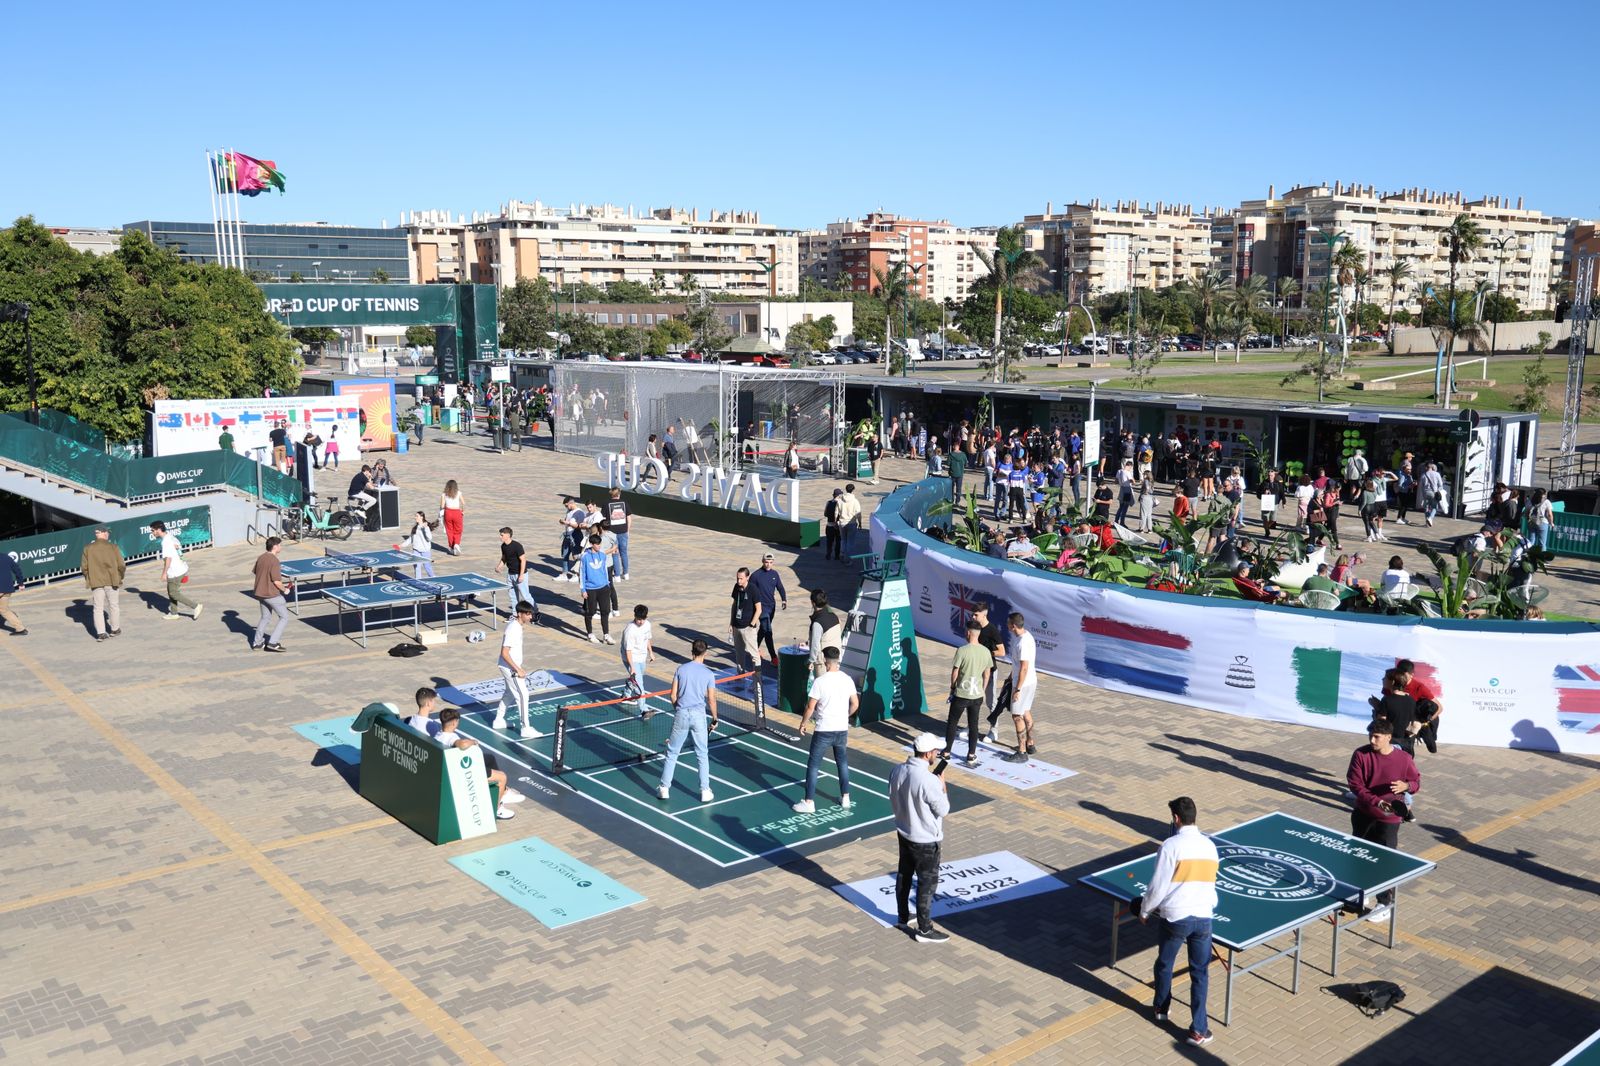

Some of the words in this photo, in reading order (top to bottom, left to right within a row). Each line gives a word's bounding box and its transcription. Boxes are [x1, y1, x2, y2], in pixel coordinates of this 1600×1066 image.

[306, 298, 338, 312] CUP
[341, 298, 362, 312] OF
[363, 298, 419, 312] TENNIS
[167, 471, 187, 480] DAVIS
[188, 469, 204, 477] CUP
[177, 518, 190, 527] CUP
[20, 547, 47, 561] DAVIS
[48, 544, 68, 555] CUP
[374, 723, 387, 742] THE
[388, 730, 413, 756] WORLD
[413, 747, 429, 763] CUP
[382, 743, 391, 758] OF
[392, 748, 418, 774] TENNIS
[464, 771, 476, 803] DAVIS
[471, 804, 482, 826] CUP
[746, 822, 781, 834] THE
[777, 808, 832, 826] WORLD
[829, 801, 857, 813] CP
[780, 825, 799, 834] OF
[800, 809, 854, 828] TENNIS
[1284, 829, 1309, 839] CUP
[1307, 831, 1350, 847] TENNIS
[1309, 836, 1352, 854] WORLD
[1274, 853, 1303, 865] CUP
[1352, 852, 1379, 863] THE
[507, 874, 528, 893] DAVIS
[527, 888, 547, 900] CUP
[970, 877, 1020, 893] 2023
[1216, 880, 1244, 891] CUP
[1247, 888, 1266, 896] OF
